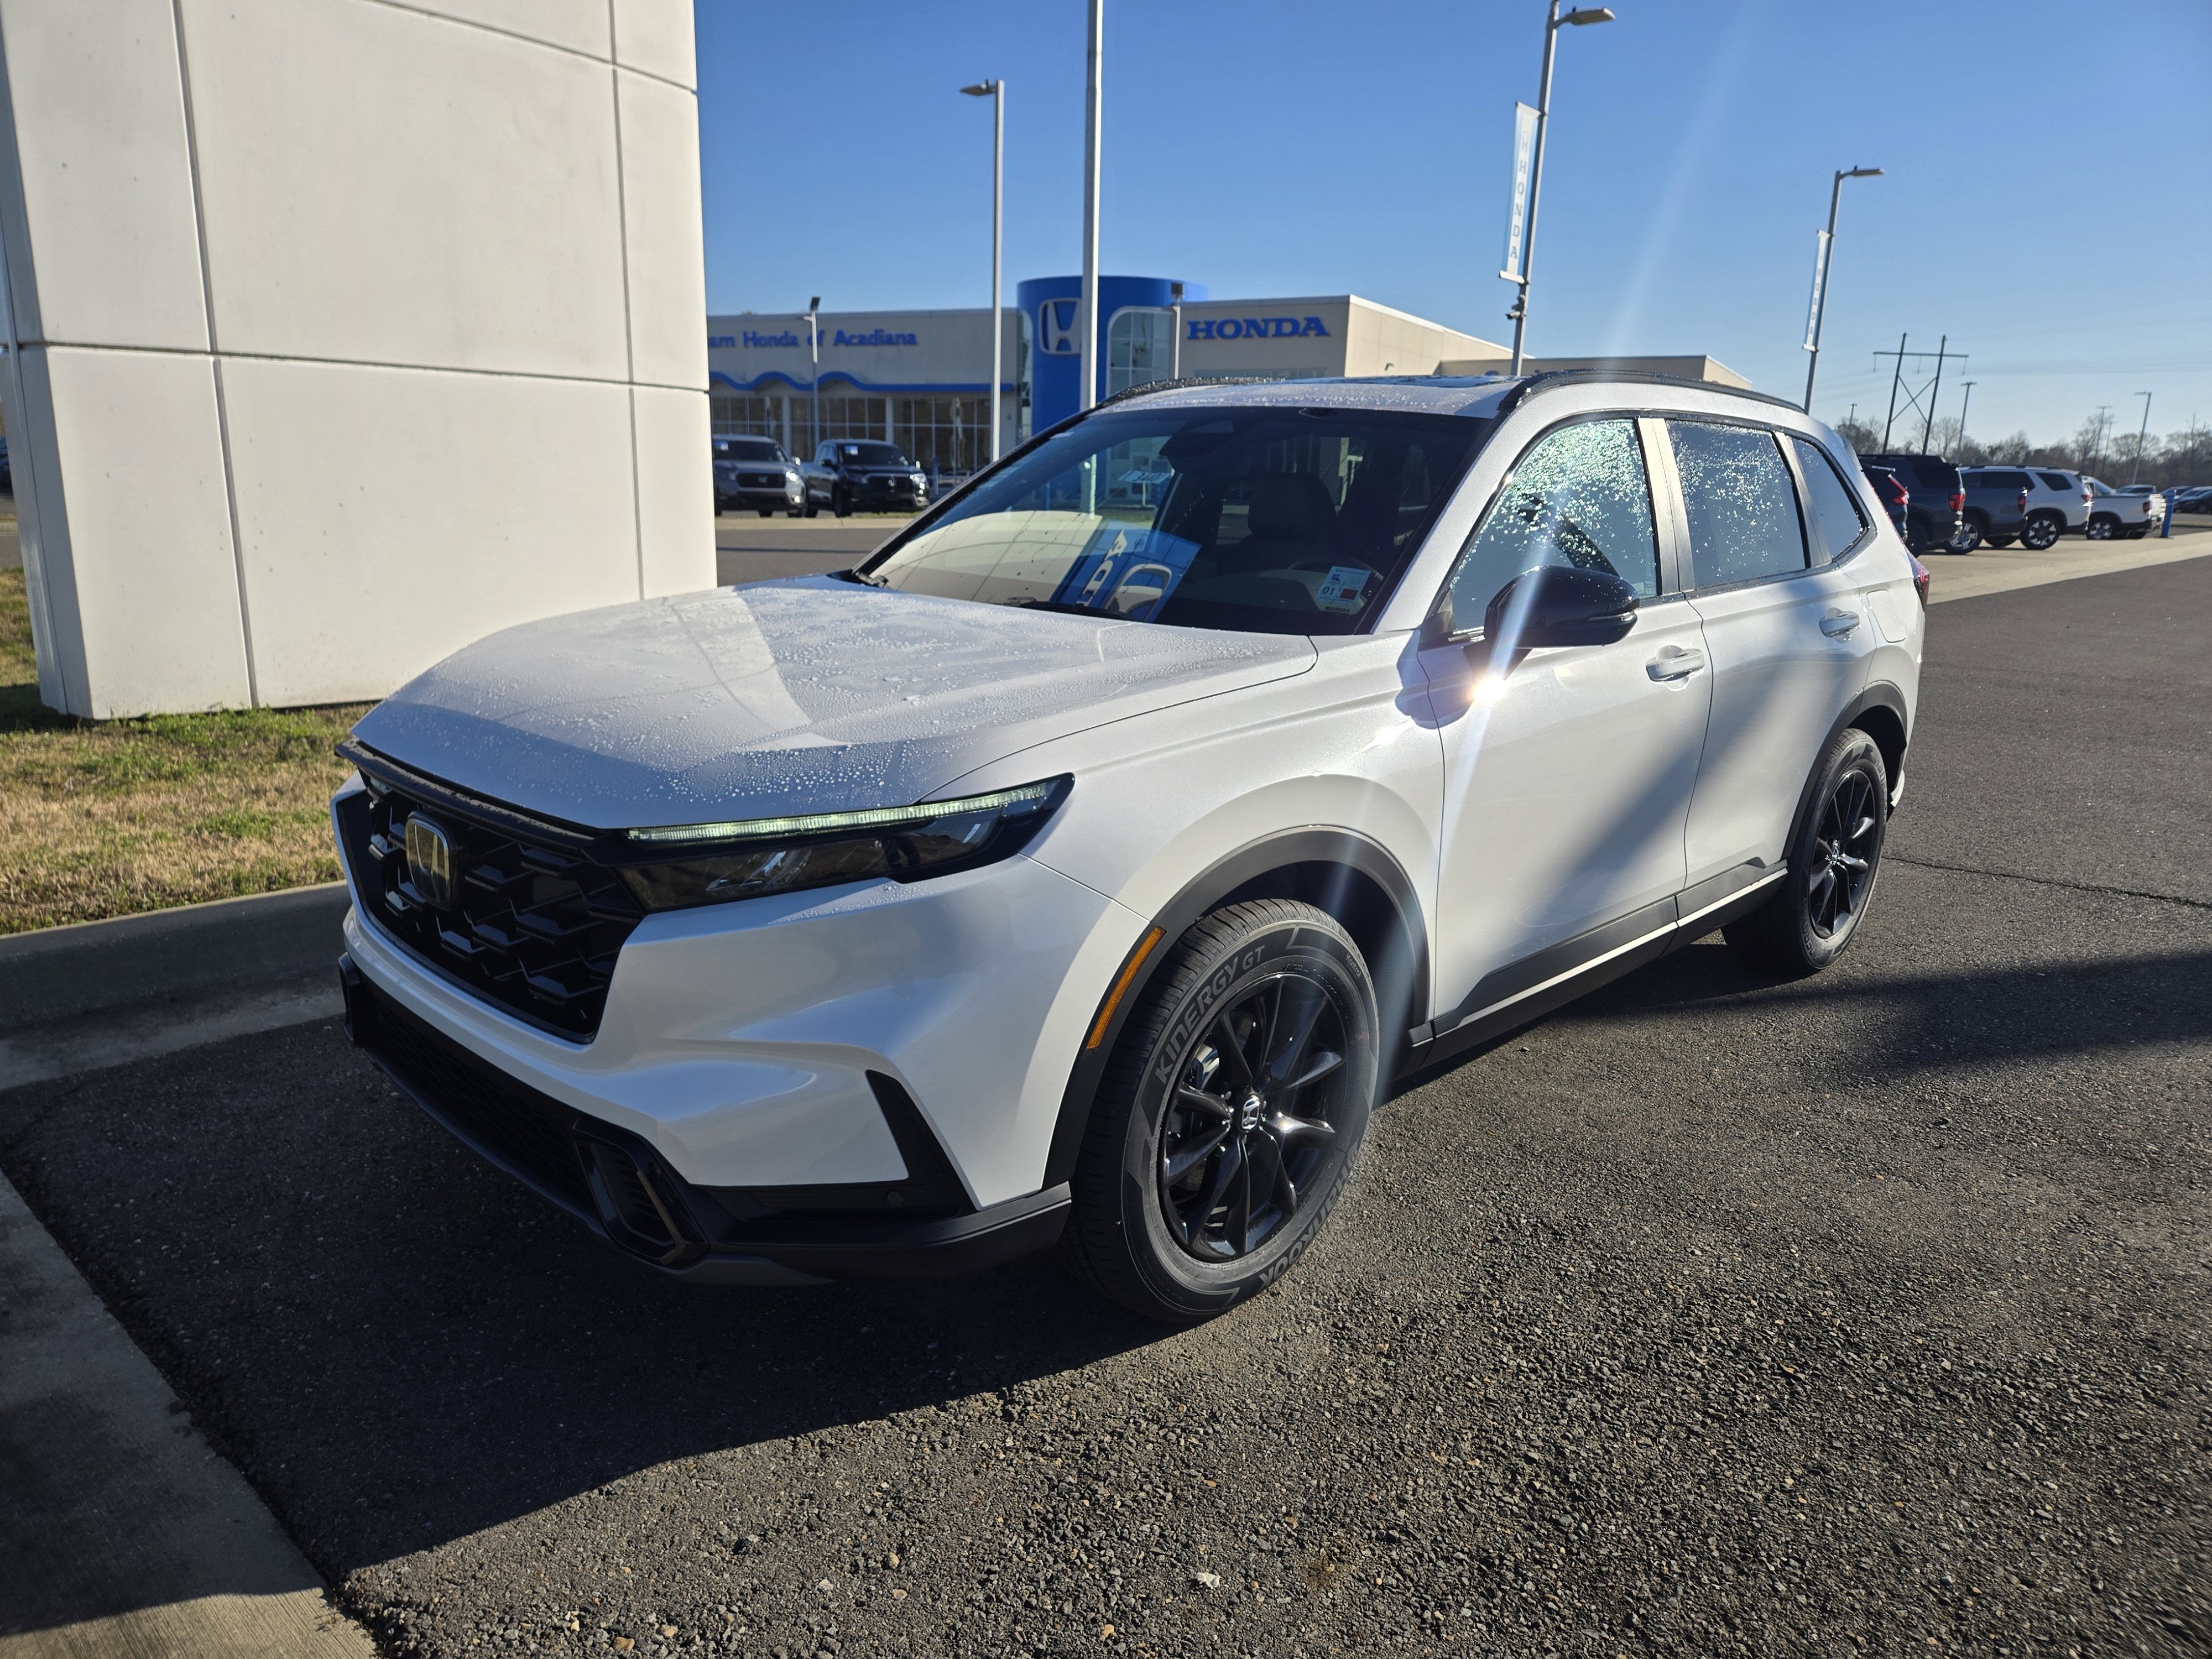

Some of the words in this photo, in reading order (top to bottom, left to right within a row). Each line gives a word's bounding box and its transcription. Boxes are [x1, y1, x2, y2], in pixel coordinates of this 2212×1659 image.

[1510, 160, 1527, 258] HONDA
[743, 331, 799, 347] Honda
[806, 330, 826, 347] of
[834, 329, 917, 347] Acadiana
[1187, 316, 1331, 340] HONDA
[1322, 586, 1335, 596] 01
[1155, 956, 1239, 1084] KINERGY
[1242, 945, 1265, 971] GT
